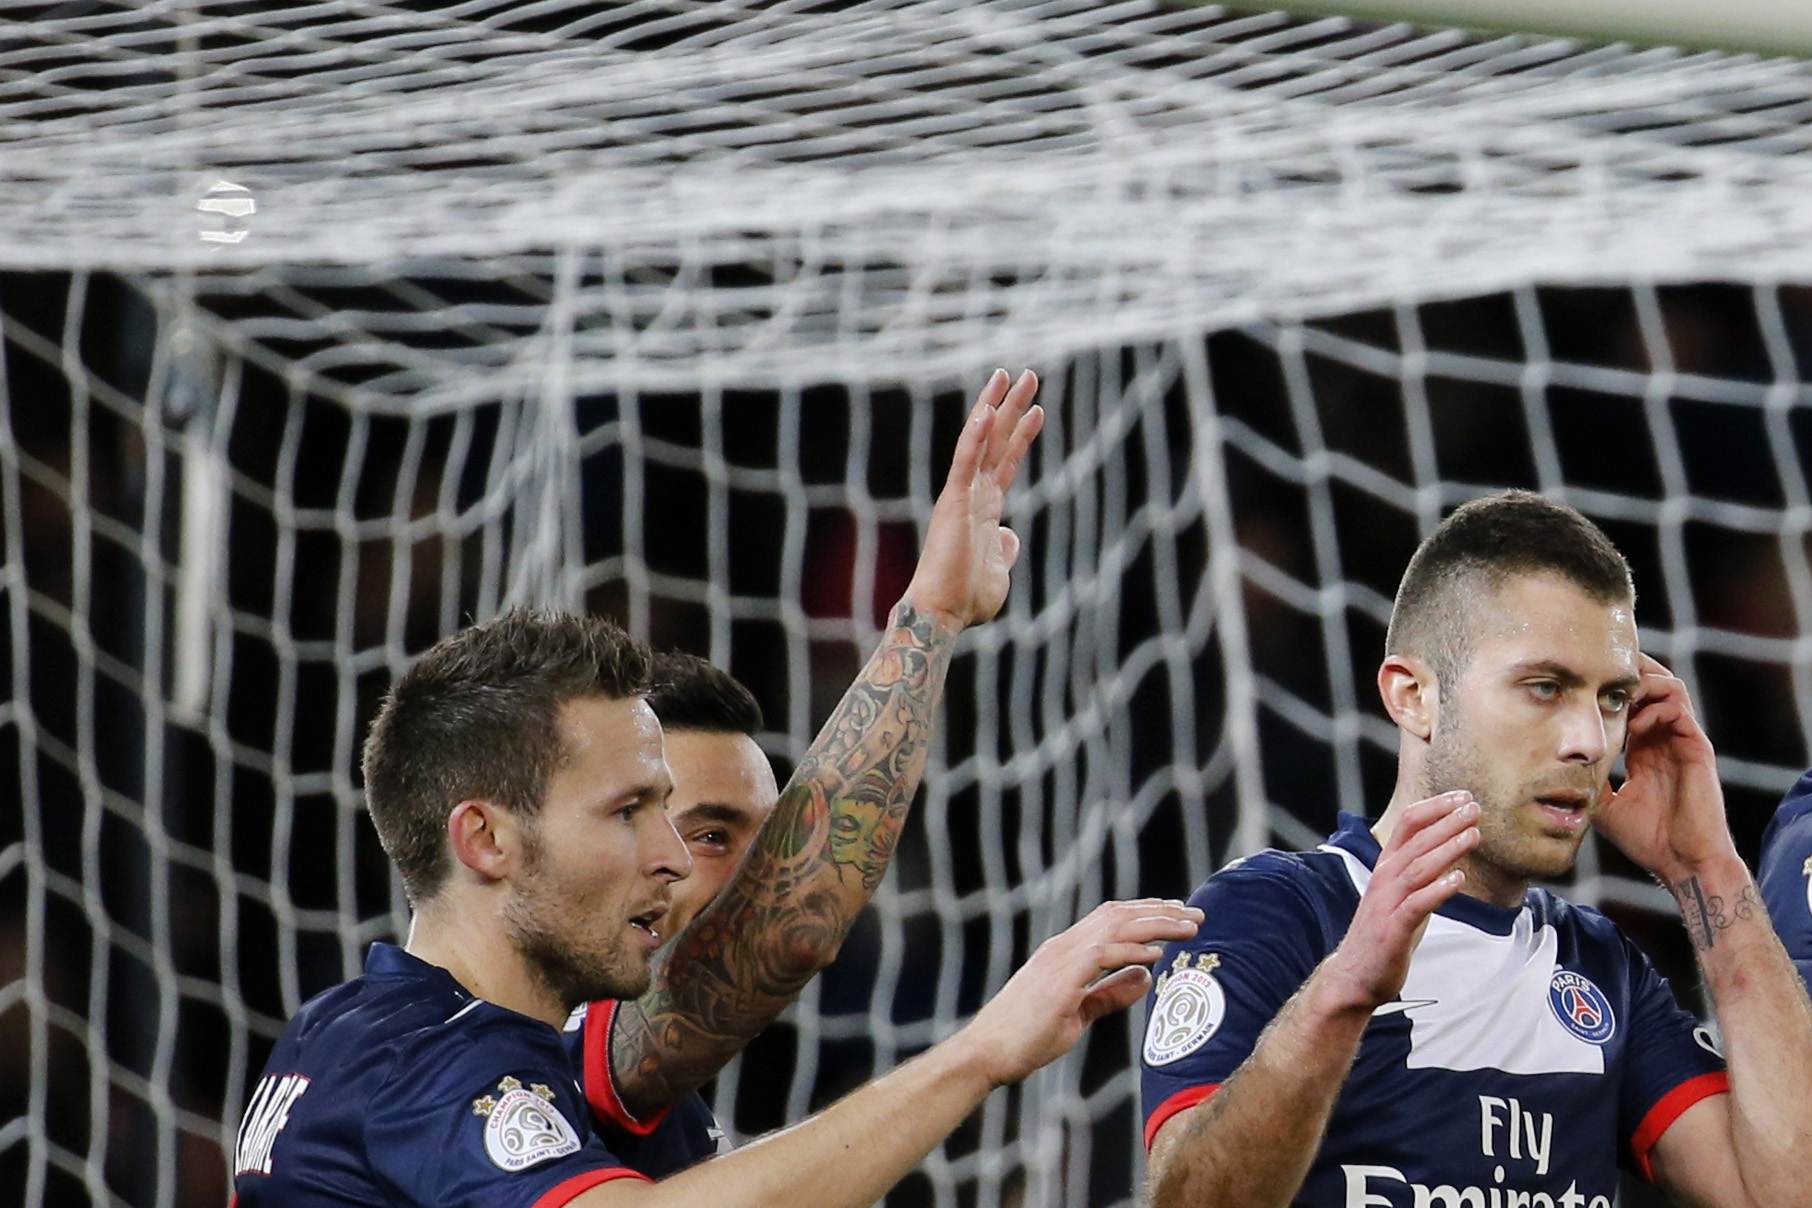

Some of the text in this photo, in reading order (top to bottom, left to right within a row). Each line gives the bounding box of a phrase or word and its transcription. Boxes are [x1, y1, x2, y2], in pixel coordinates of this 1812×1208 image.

[1191, 973, 1212, 988] 2013
[1552, 974, 1591, 993] PARIS
[489, 1092, 531, 1130] CHAMPION
[1479, 1095, 1553, 1175] Fly
